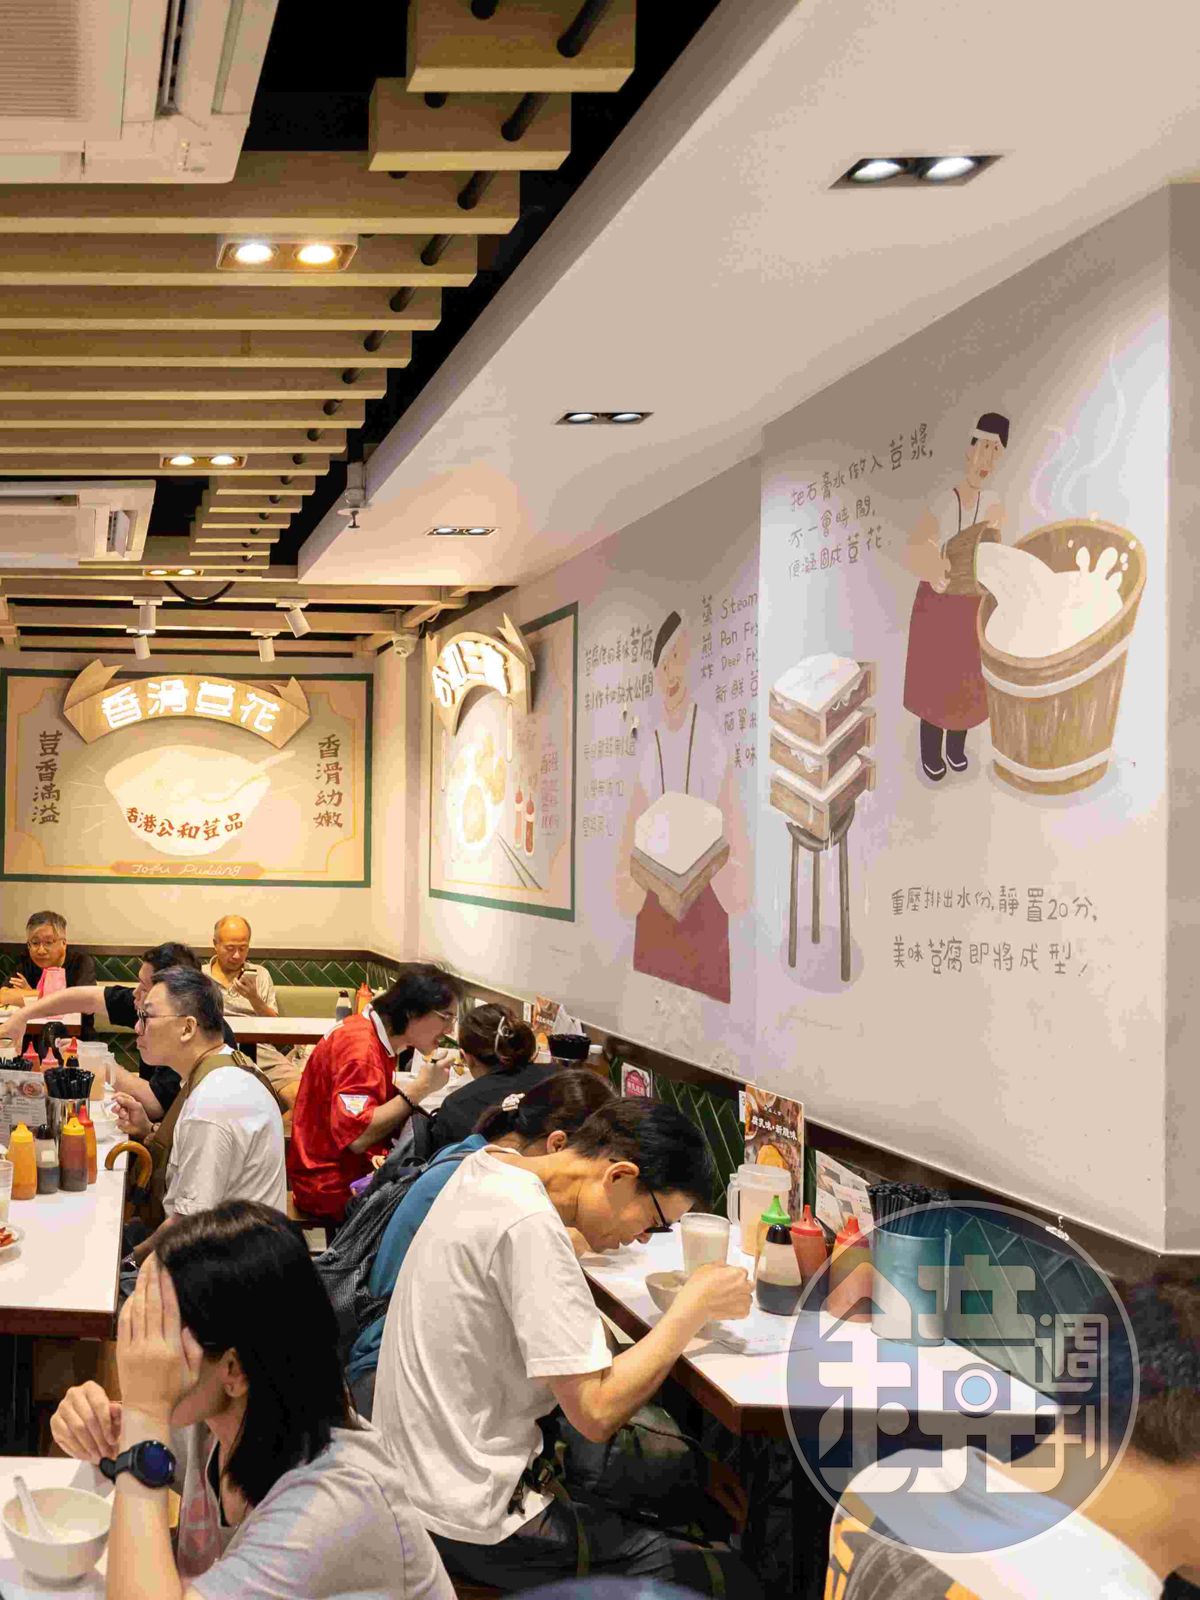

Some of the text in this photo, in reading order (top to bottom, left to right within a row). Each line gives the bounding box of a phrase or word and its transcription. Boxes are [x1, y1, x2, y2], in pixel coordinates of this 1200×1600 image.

[720, 630, 738, 648] Pan
[31, 730, 63, 825] 荳香滿溢
[313, 734, 344, 829] 香滑幼嫩
[127, 807, 244, 841] 香港公和荳品
[131, 862, 242, 877] Tofu Pudding
